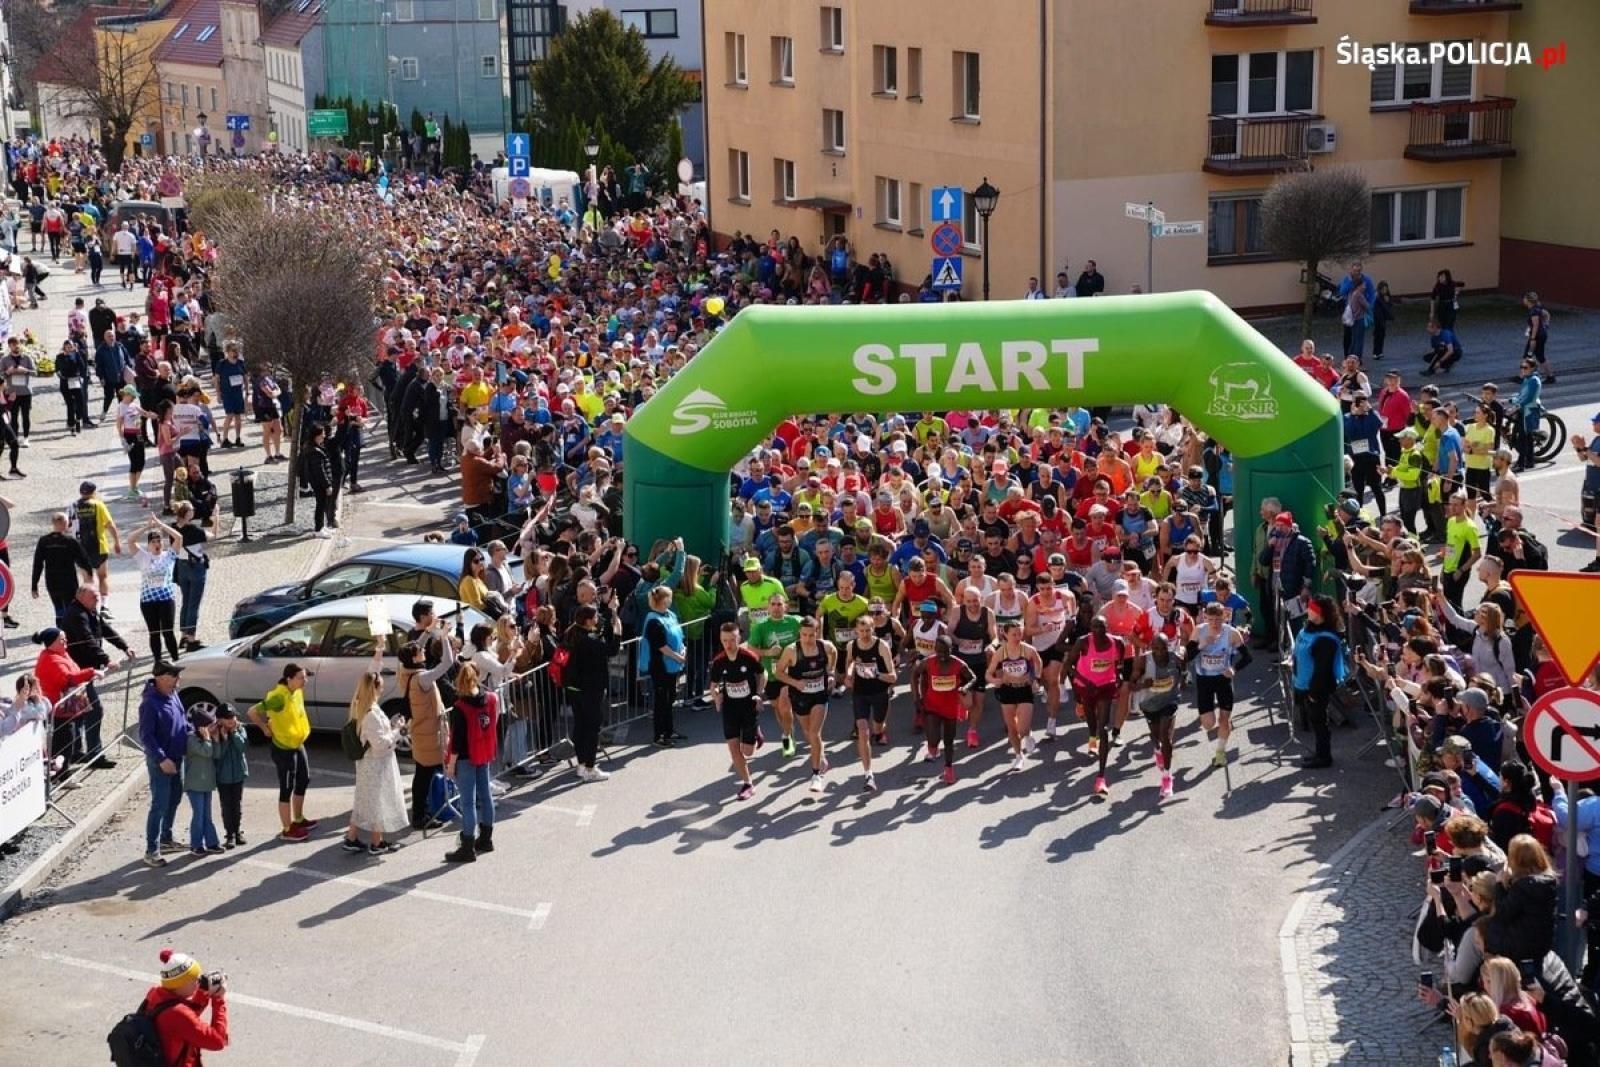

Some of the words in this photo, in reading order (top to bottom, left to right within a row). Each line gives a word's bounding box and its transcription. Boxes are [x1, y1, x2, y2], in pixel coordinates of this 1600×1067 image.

[513, 158, 526, 175] P
[852, 338, 1099, 395] START
[713, 417, 758, 429] SOBÓTKA
